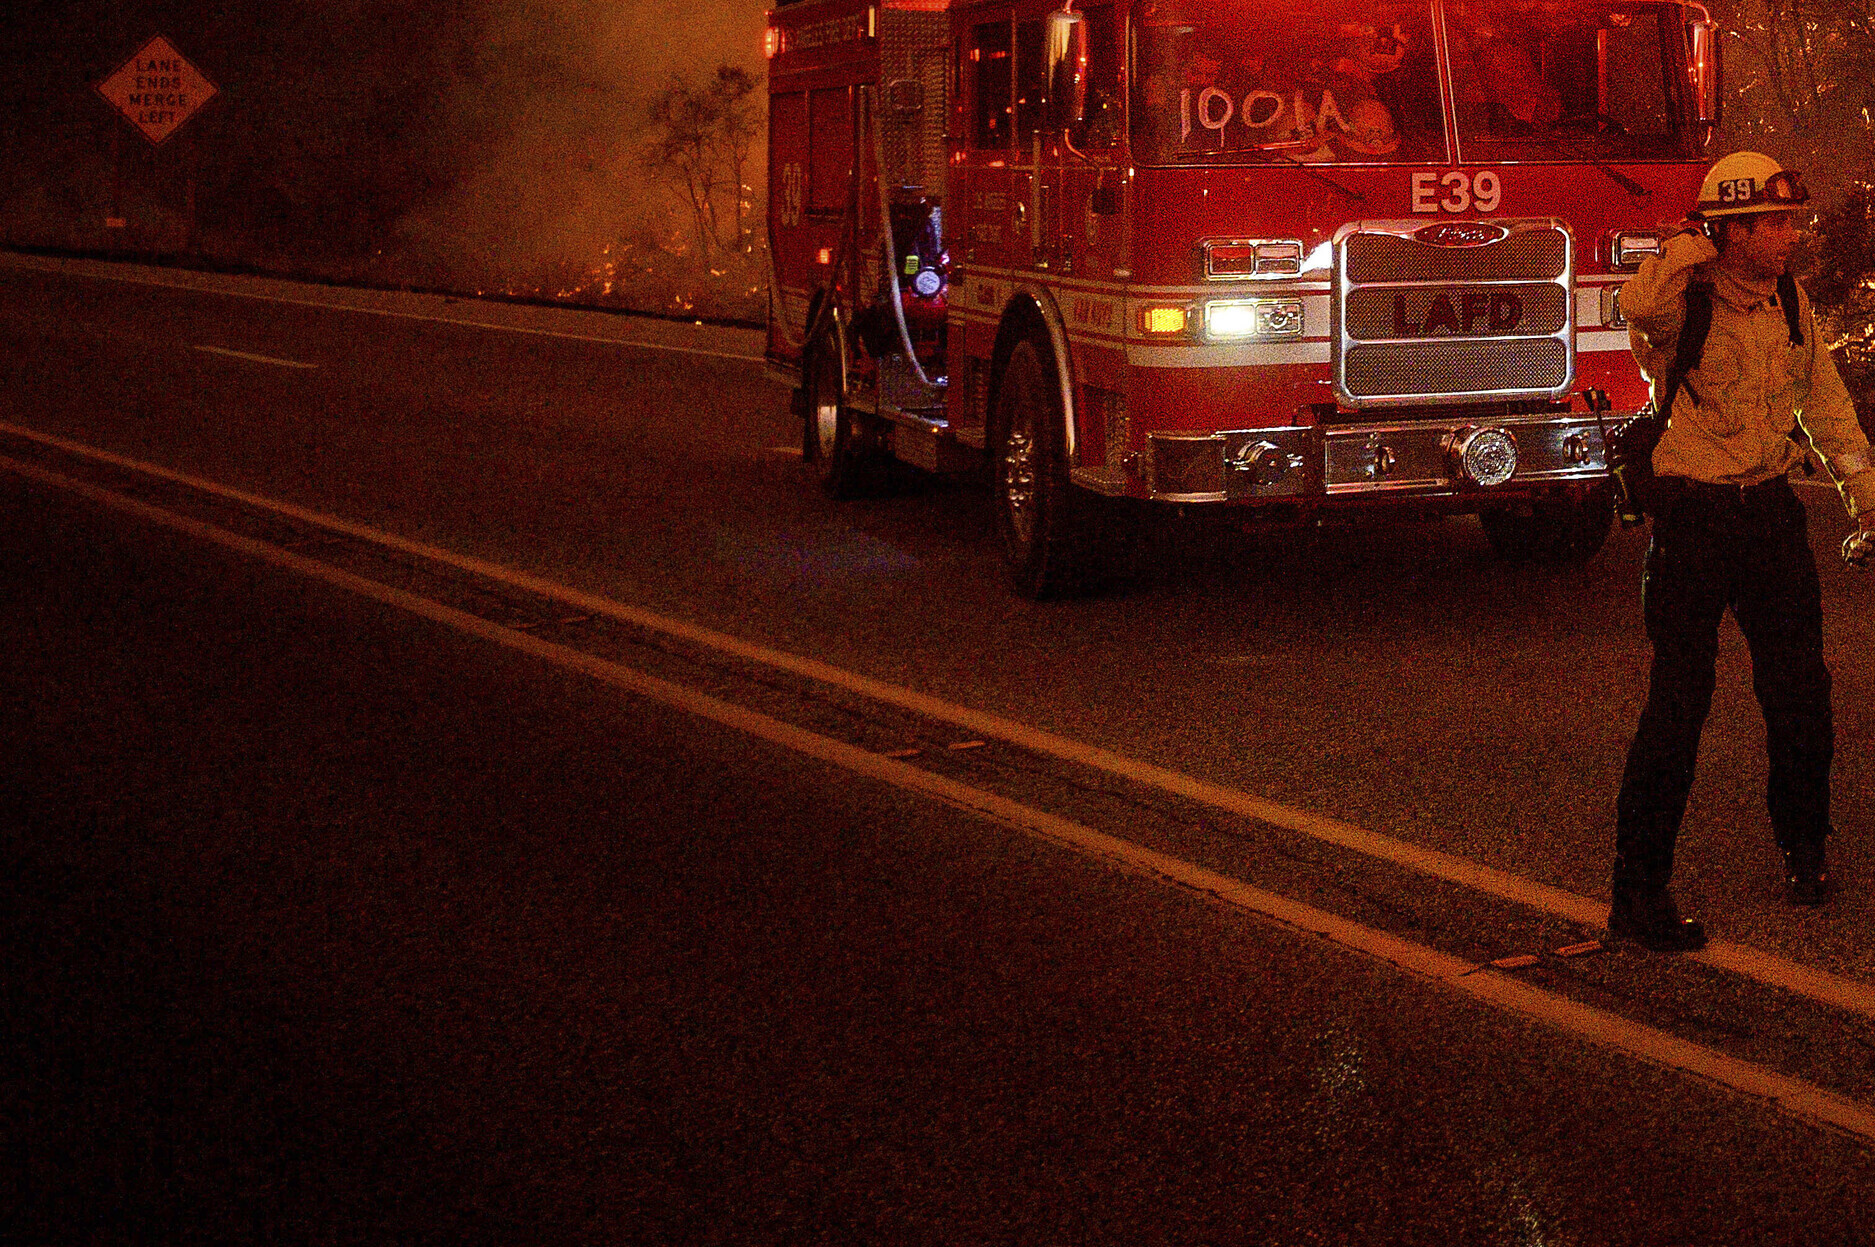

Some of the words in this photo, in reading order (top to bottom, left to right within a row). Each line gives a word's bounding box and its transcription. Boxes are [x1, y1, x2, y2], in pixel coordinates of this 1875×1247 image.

[136, 59, 181, 72] LANE
[136, 76, 182, 89] ENDS
[129, 93, 187, 107] MERGE
[138, 110, 175, 124] LEFT
[780, 162, 802, 227] 39
[1411, 170, 1502, 213] E39
[1721, 178, 1752, 203] 39
[1393, 292, 1523, 333] LAFD
